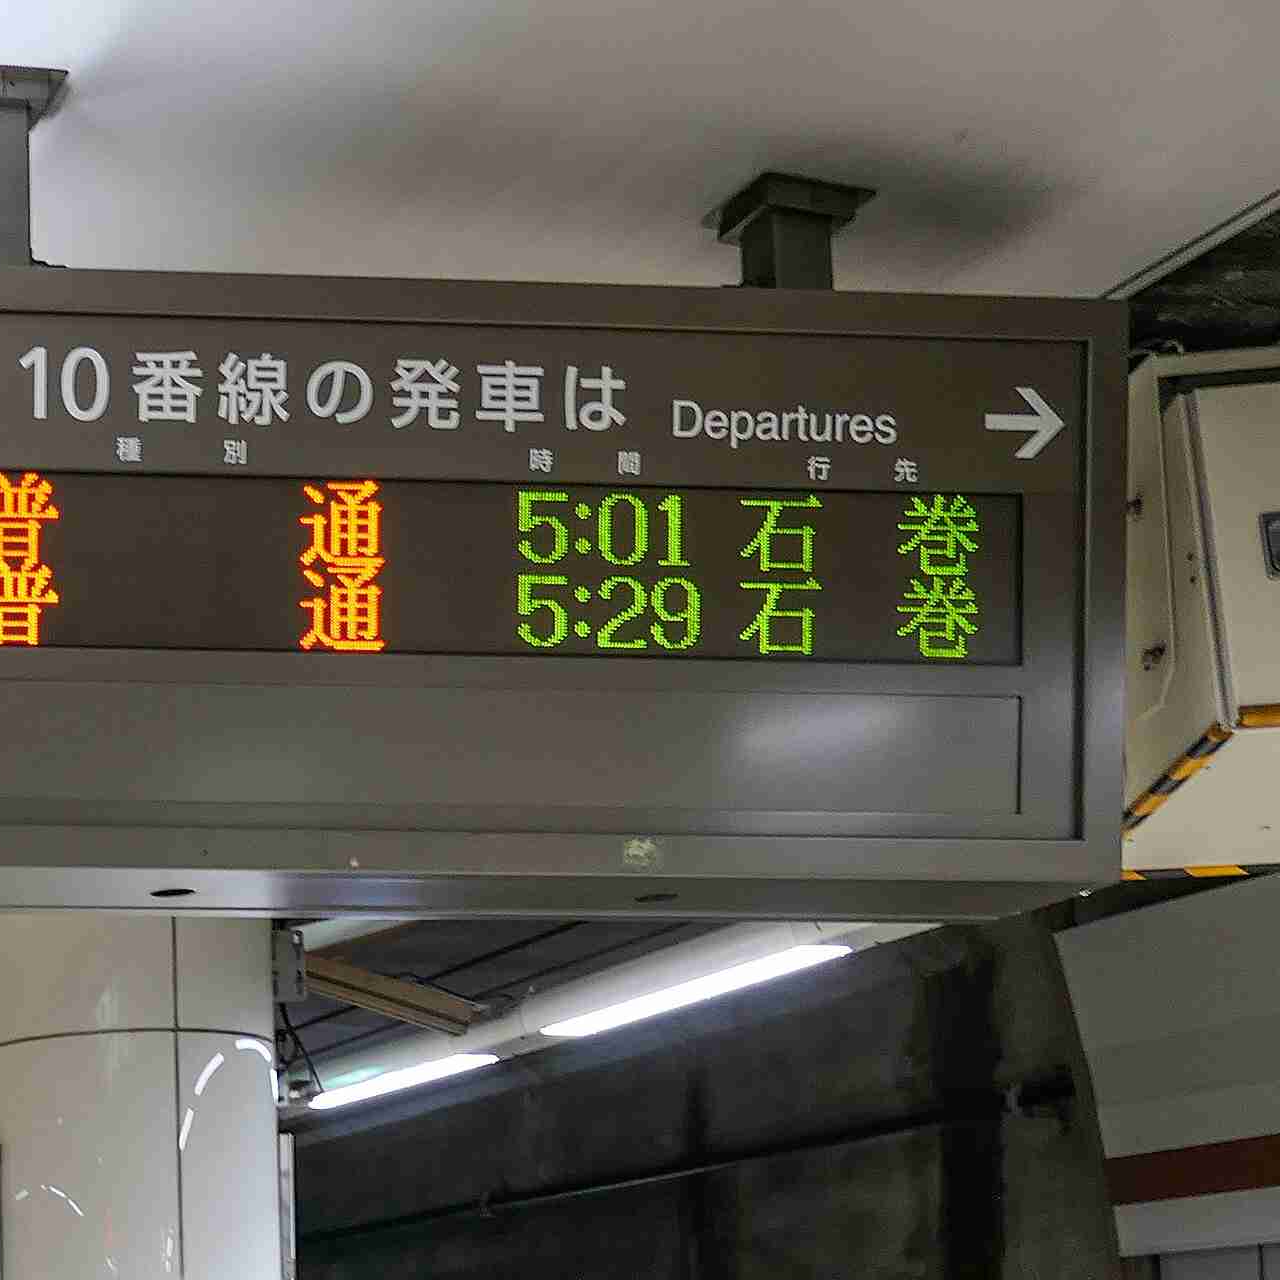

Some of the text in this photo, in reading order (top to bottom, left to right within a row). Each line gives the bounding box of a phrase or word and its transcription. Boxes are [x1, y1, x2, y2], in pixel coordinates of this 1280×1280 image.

[672, 399, 898, 448] Departures
[517, 489, 691, 568] 5:01
[517, 574, 702, 651] 5:29
